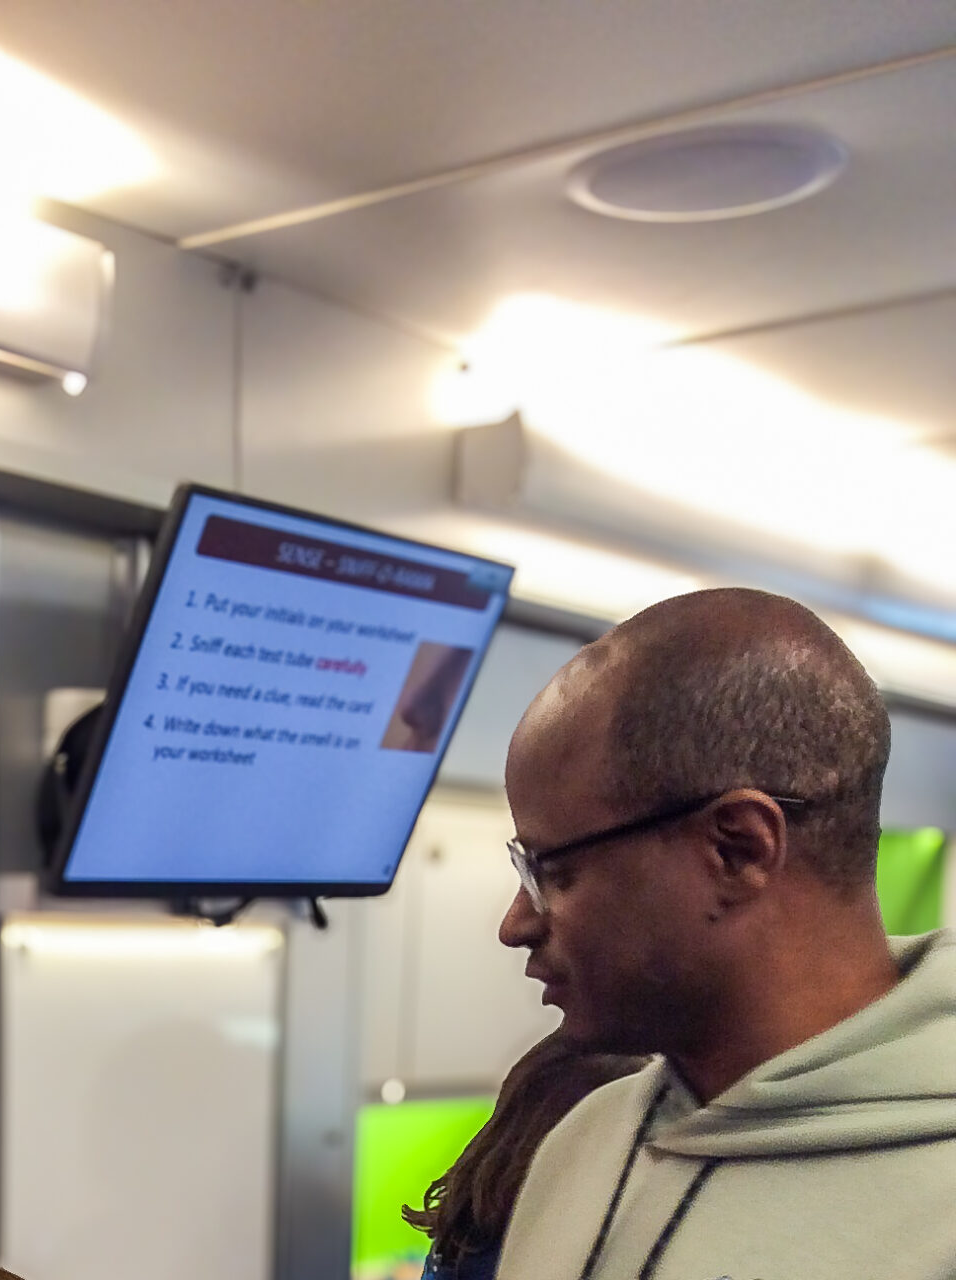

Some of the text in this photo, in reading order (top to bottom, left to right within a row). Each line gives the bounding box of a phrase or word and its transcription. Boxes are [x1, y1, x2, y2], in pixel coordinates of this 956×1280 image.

[204, 592, 230, 613] Put
[230, 602, 263, 619] your
[189, 634, 225, 654] Sniff
[223, 642, 255, 660] each
[257, 646, 284, 664] test
[284, 650, 314, 669] tube
[315, 656, 368, 680] carefully
[188, 681, 216, 698] you
[216, 683, 252, 700] need
[164, 715, 201, 736] Write
[202, 718, 241, 738] down
[243, 726, 277, 743] what
[276, 728, 299, 747] the
[153, 745, 257, 767] your worksheet
